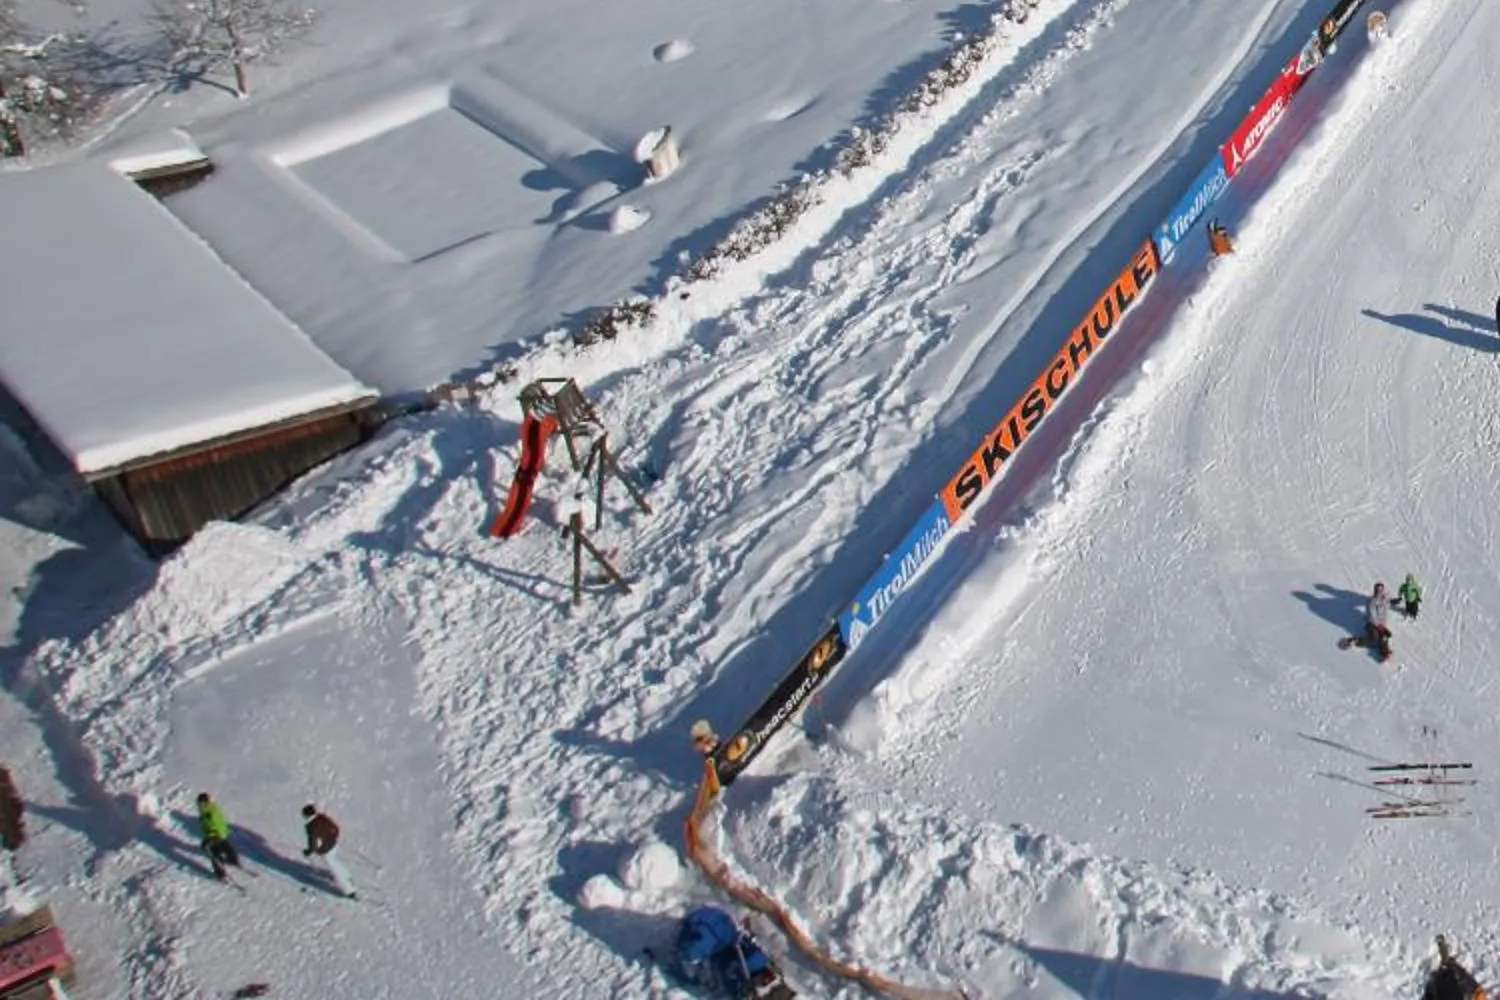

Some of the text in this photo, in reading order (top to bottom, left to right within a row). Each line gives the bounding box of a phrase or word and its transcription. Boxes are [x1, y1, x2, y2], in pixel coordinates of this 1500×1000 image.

[1241, 95, 1283, 158] ATOMIC
[955, 249, 1152, 510] SKISCHULE
[867, 517, 949, 622] TirolMilch
